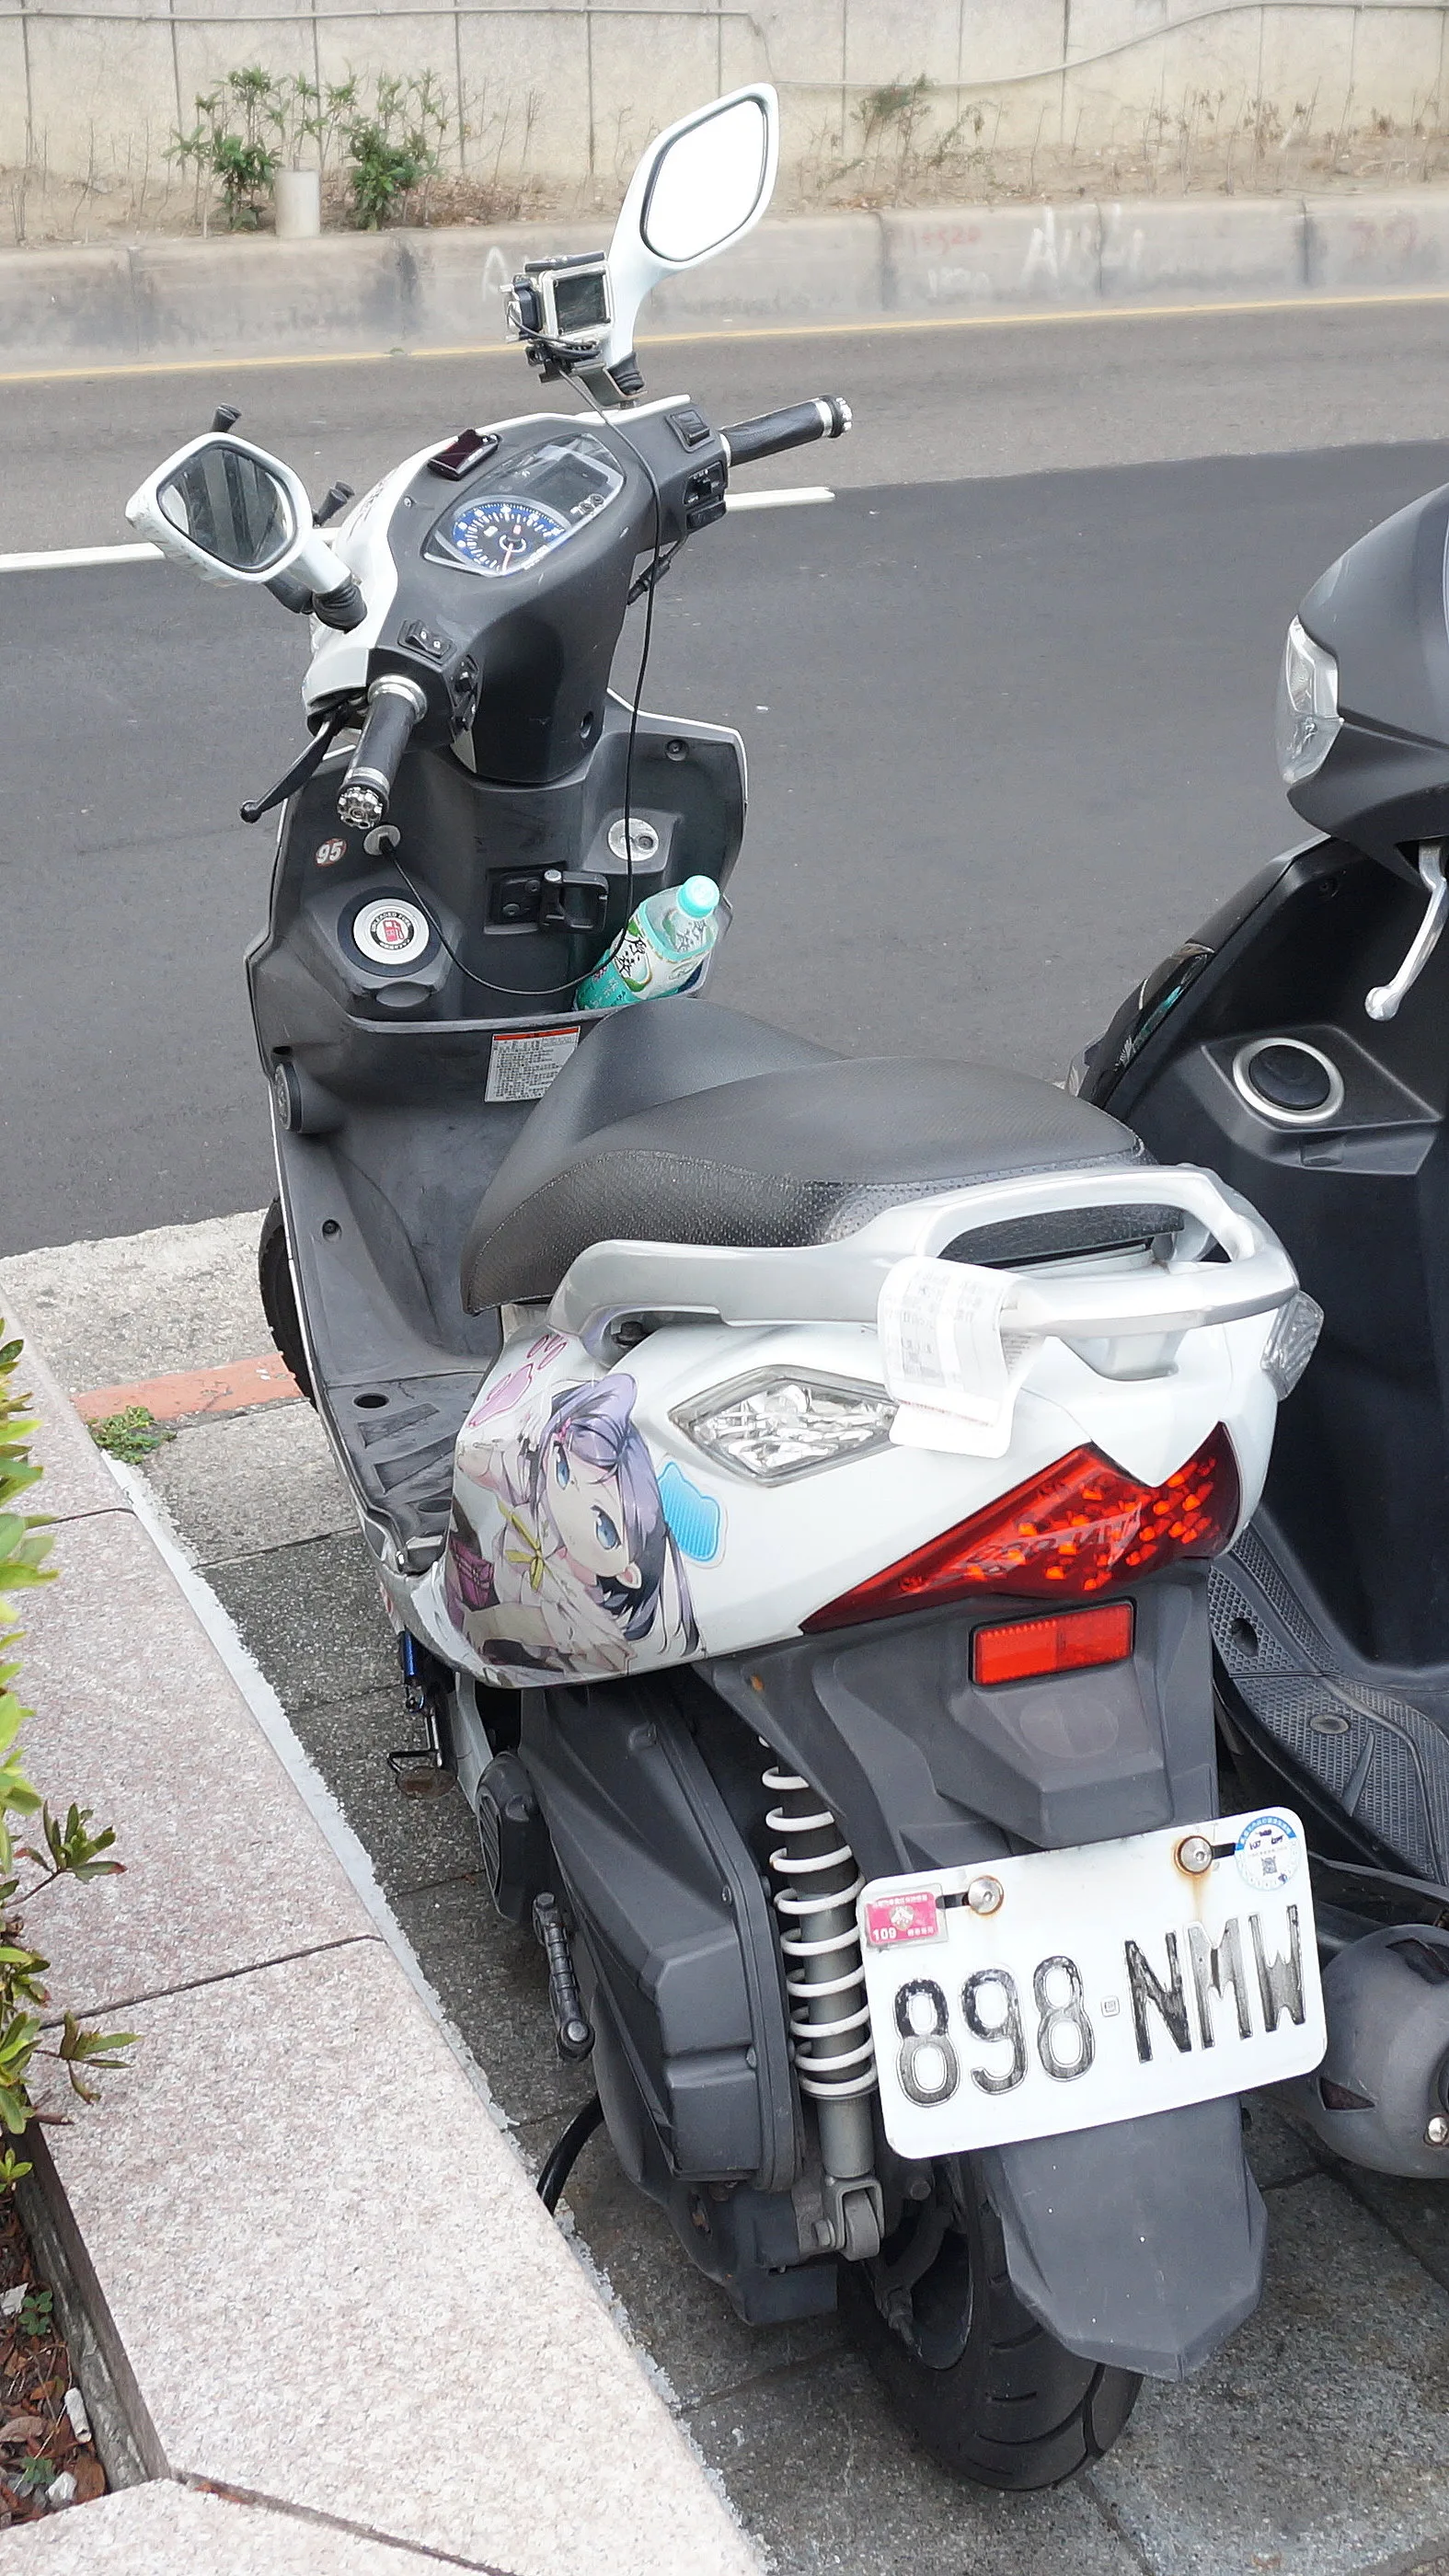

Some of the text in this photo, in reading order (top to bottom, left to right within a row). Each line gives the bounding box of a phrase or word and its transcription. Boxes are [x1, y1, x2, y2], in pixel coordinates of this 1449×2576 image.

[316, 840, 344, 865] 95
[614, 937, 648, 979] 原萃
[872, 1926, 897, 1941] 109
[893, 1904, 1306, 2108] 898 NMW
